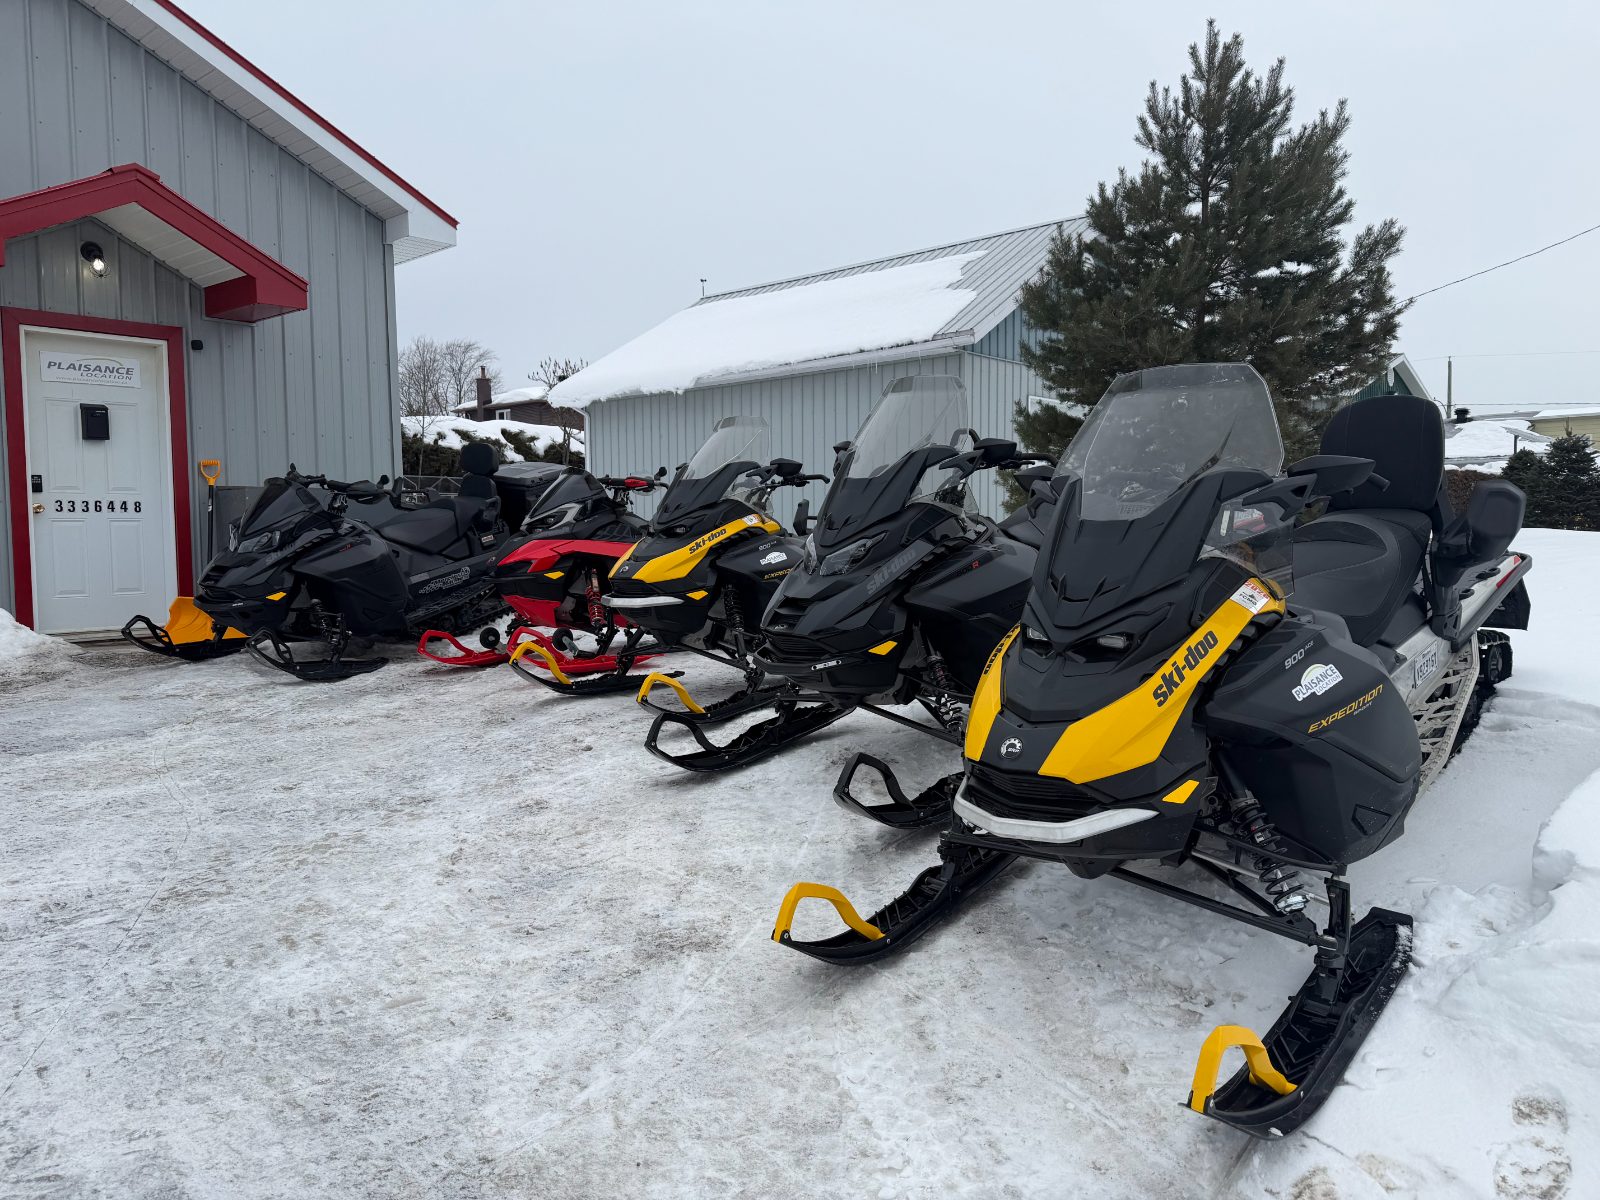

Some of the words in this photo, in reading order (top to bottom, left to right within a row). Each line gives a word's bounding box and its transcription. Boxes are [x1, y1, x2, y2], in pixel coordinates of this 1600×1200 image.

[47, 361, 135, 375] PLAISANCE
[80, 372, 132, 381] LOCATION
[55, 500, 142, 513] 3336448
[688, 528, 727, 554] ski-doo
[866, 549, 917, 595] ski-doo
[1152, 630, 1219, 708] ski-doo
[1284, 648, 1305, 670] 900
[1294, 666, 1338, 699] PLAISANCE
[1316, 674, 1341, 694] LOCATION
[1308, 684, 1383, 733] EXPEDITION
